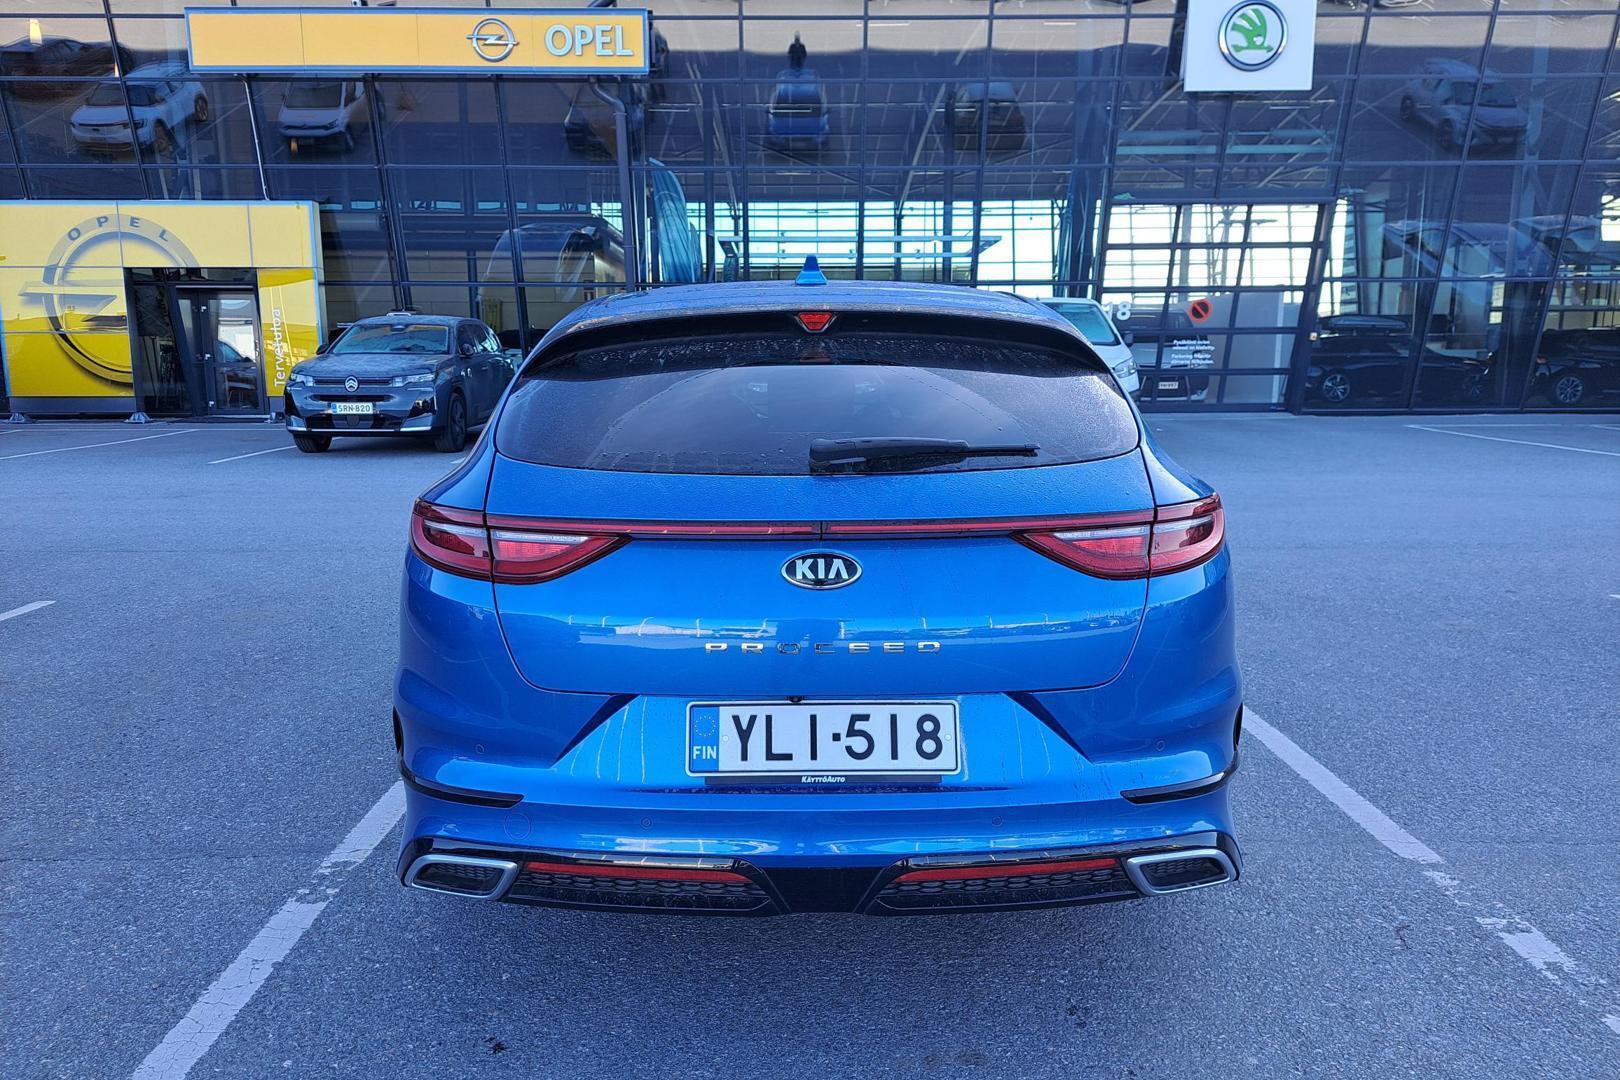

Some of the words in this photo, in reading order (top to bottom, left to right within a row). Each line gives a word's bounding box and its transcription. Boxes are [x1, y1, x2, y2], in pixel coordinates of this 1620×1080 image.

[545, 24, 634, 57] OPEL
[67, 215, 169, 242] OPEL
[270, 307, 286, 387] Tervetuloa
[337, 404, 371, 412] SRN-820
[795, 558, 849, 580] KIA
[704, 641, 942, 655] PROCEED
[693, 745, 717, 760] FIN
